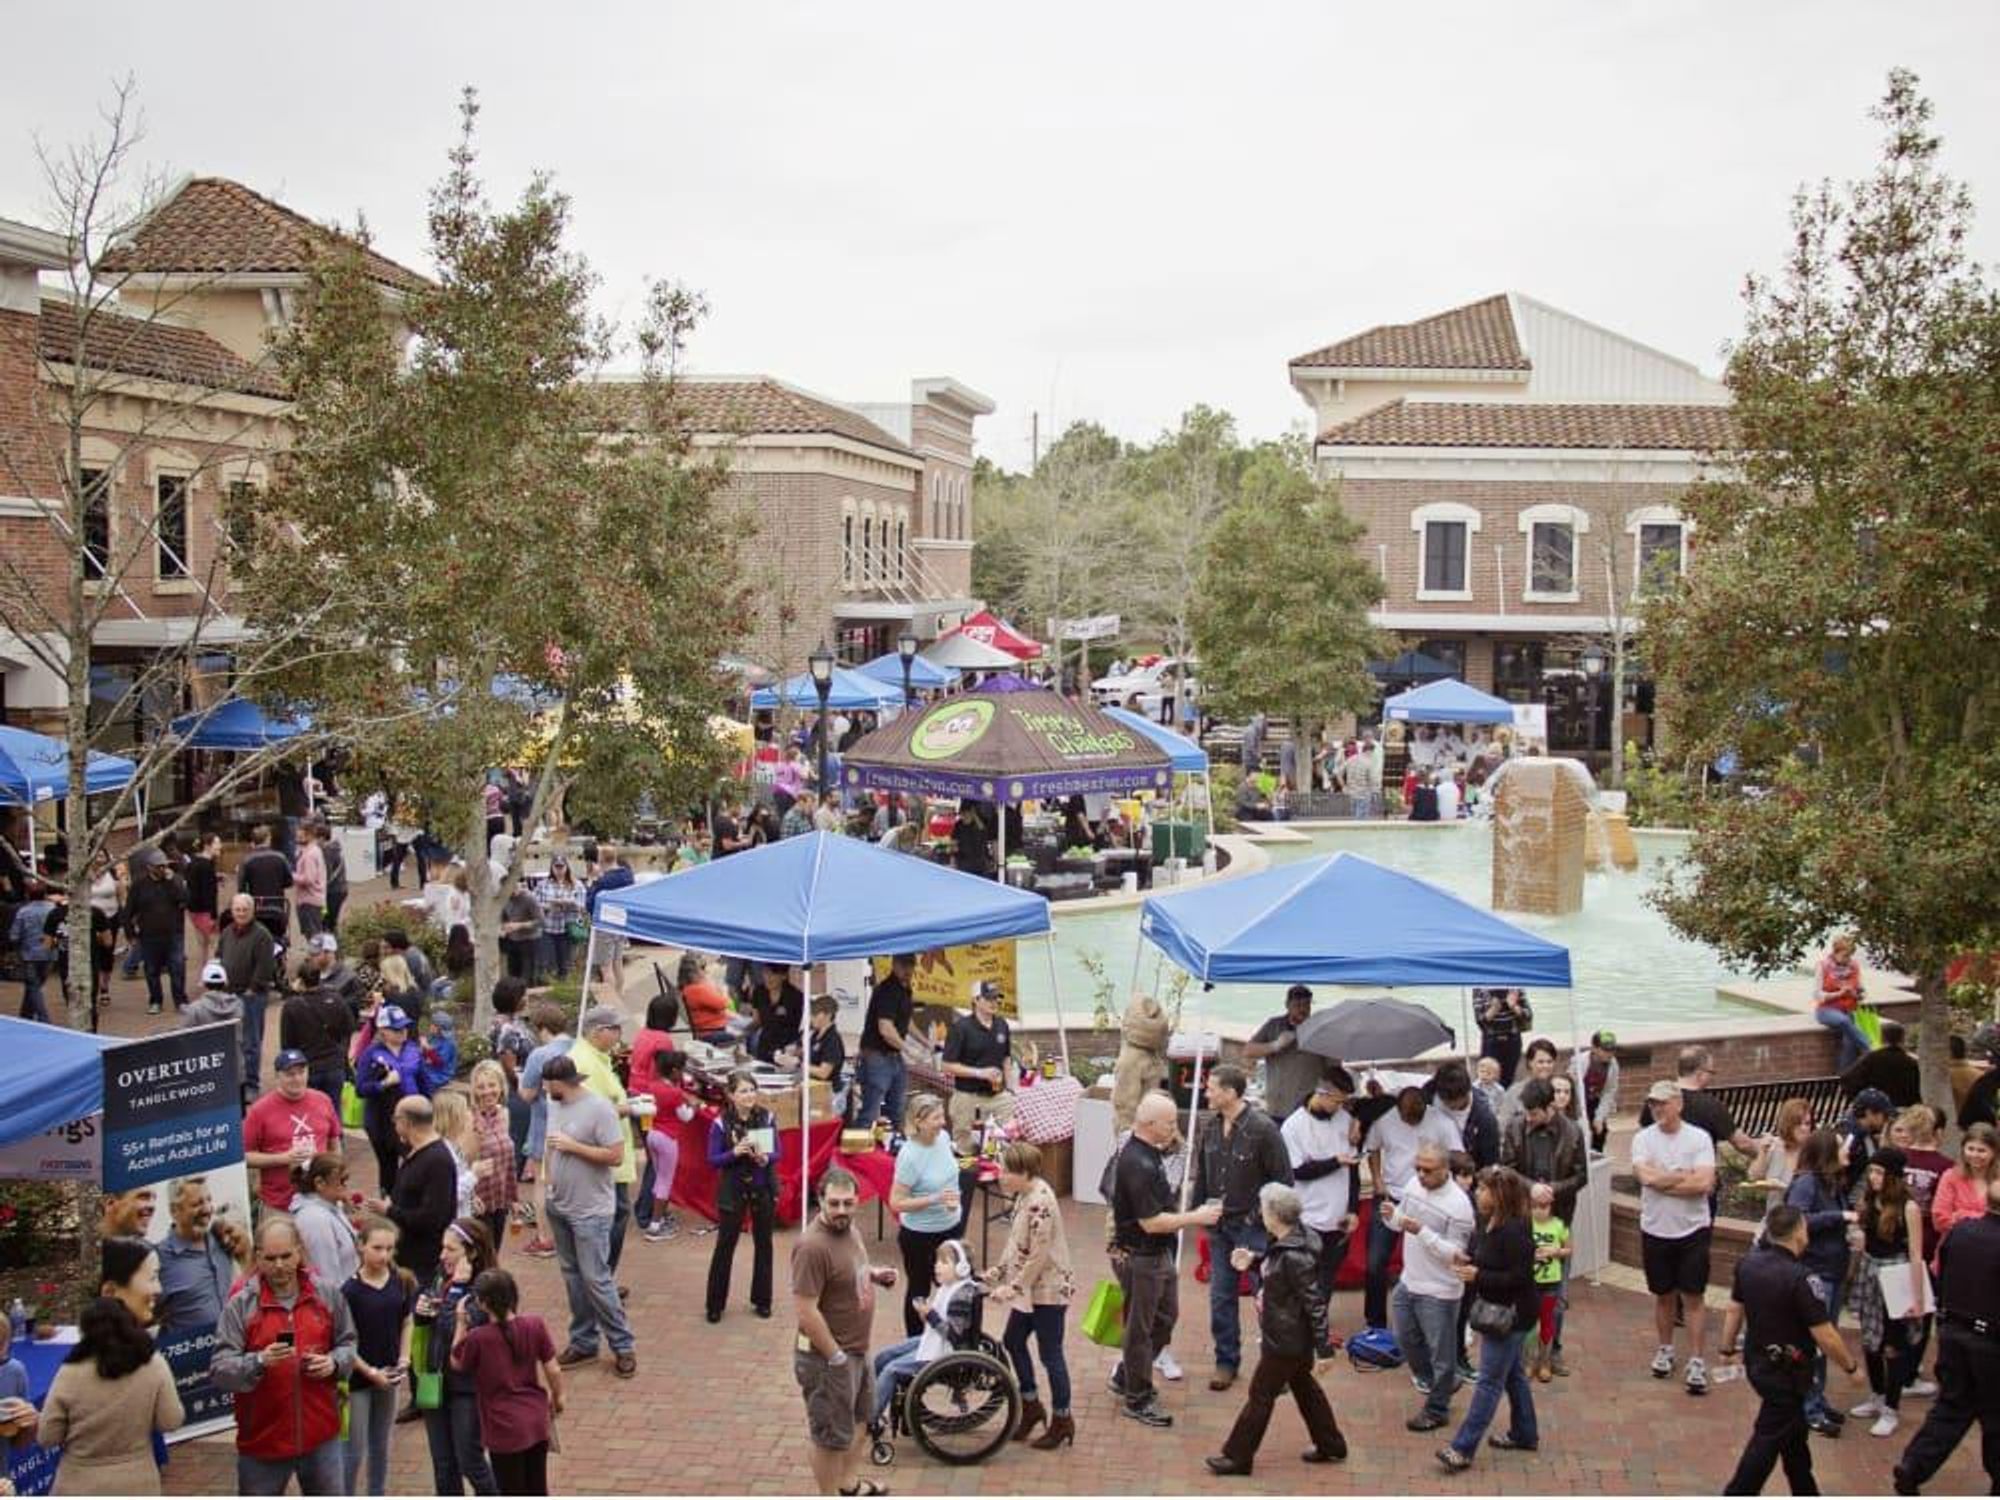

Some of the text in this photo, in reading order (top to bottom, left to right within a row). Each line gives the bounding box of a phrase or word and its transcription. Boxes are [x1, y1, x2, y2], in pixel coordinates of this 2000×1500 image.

[118, 1053, 224, 1087] OVERTURE
[129, 1082, 216, 1109] TANGLEWOOD
[148, 1130, 193, 1148] Rentals
[196, 1126, 213, 1139] for
[215, 1123, 230, 1134] an
[127, 1137, 228, 1172] Active Adult Life
